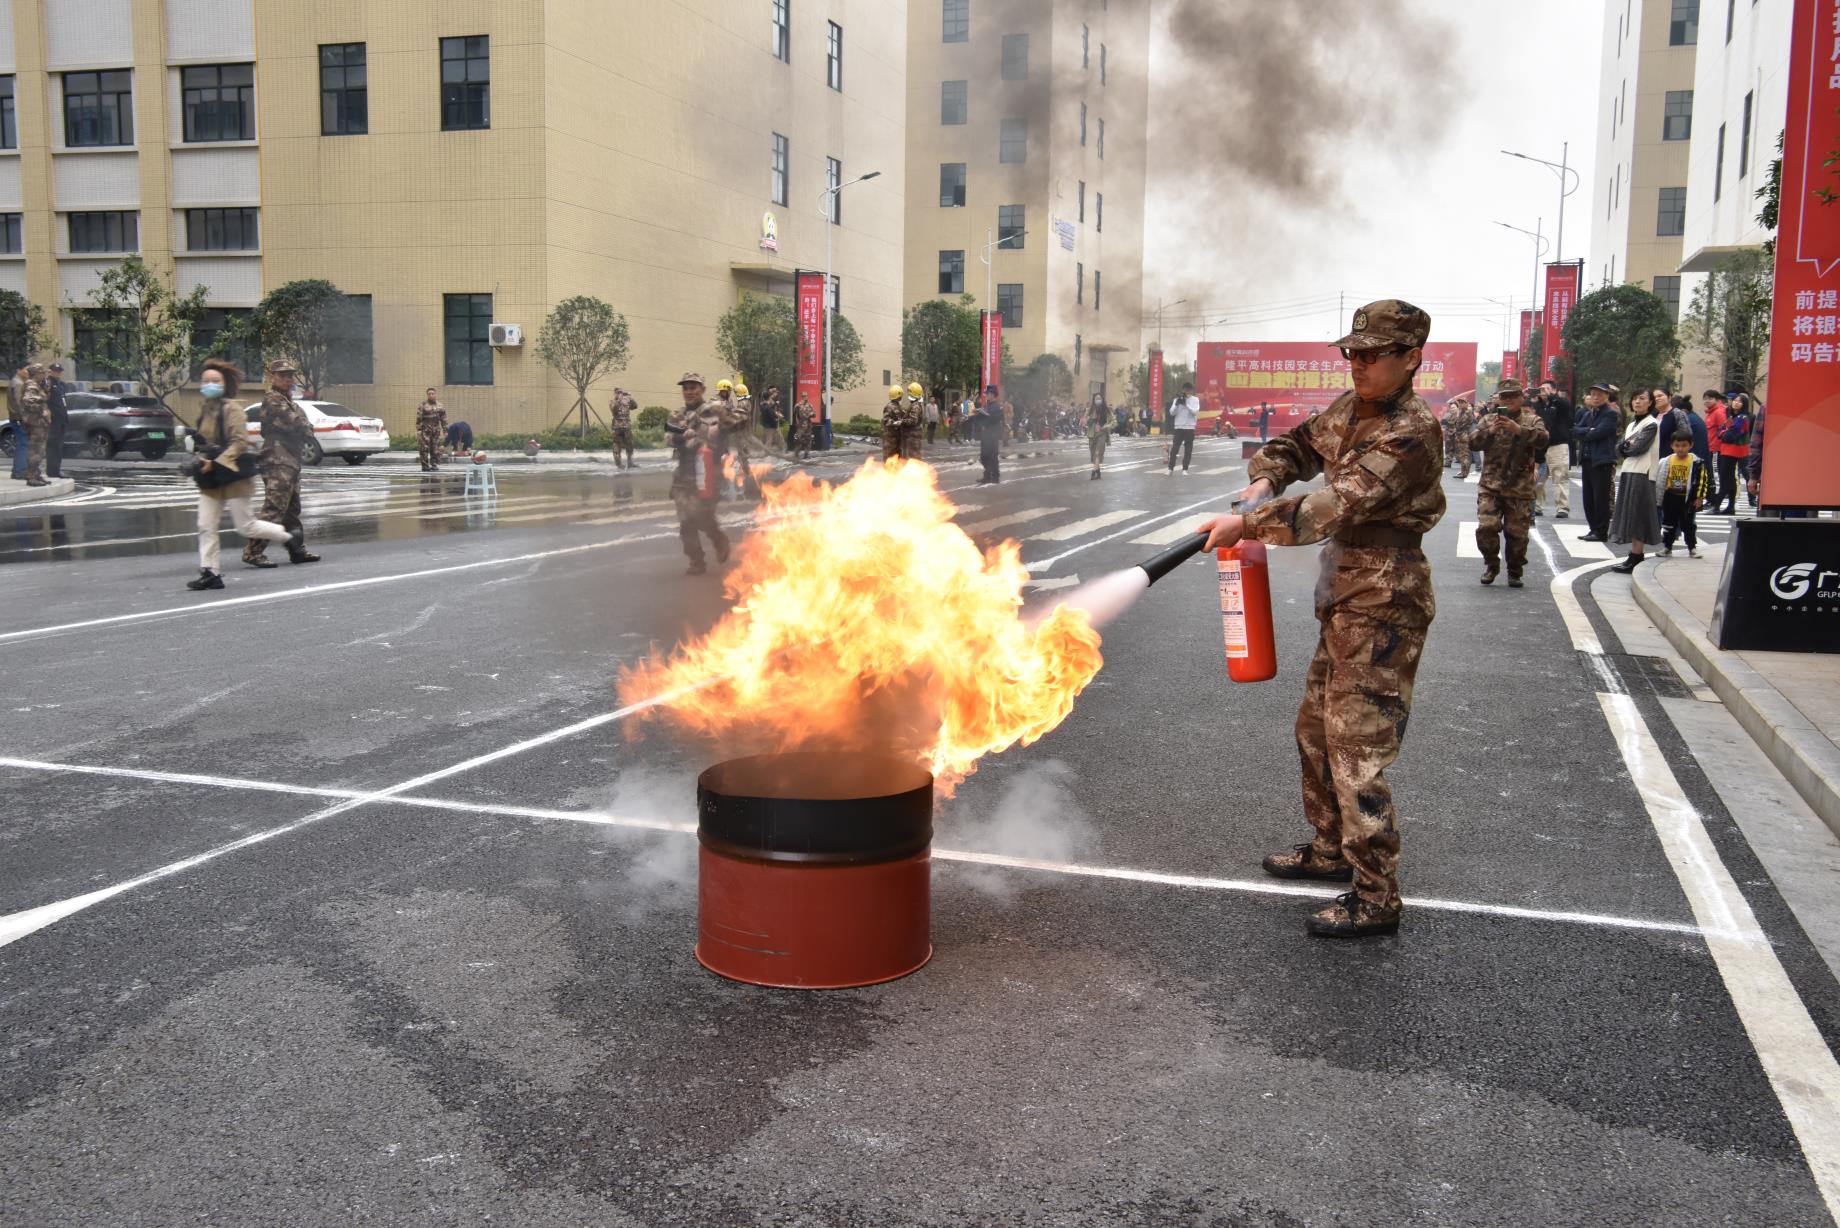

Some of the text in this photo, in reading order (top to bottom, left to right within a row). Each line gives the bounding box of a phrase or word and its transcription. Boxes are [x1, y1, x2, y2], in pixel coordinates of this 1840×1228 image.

[1795, 290, 1840, 311] 前提
[1793, 315, 1840, 336] 将银
[1817, 570, 1840, 589] 广
